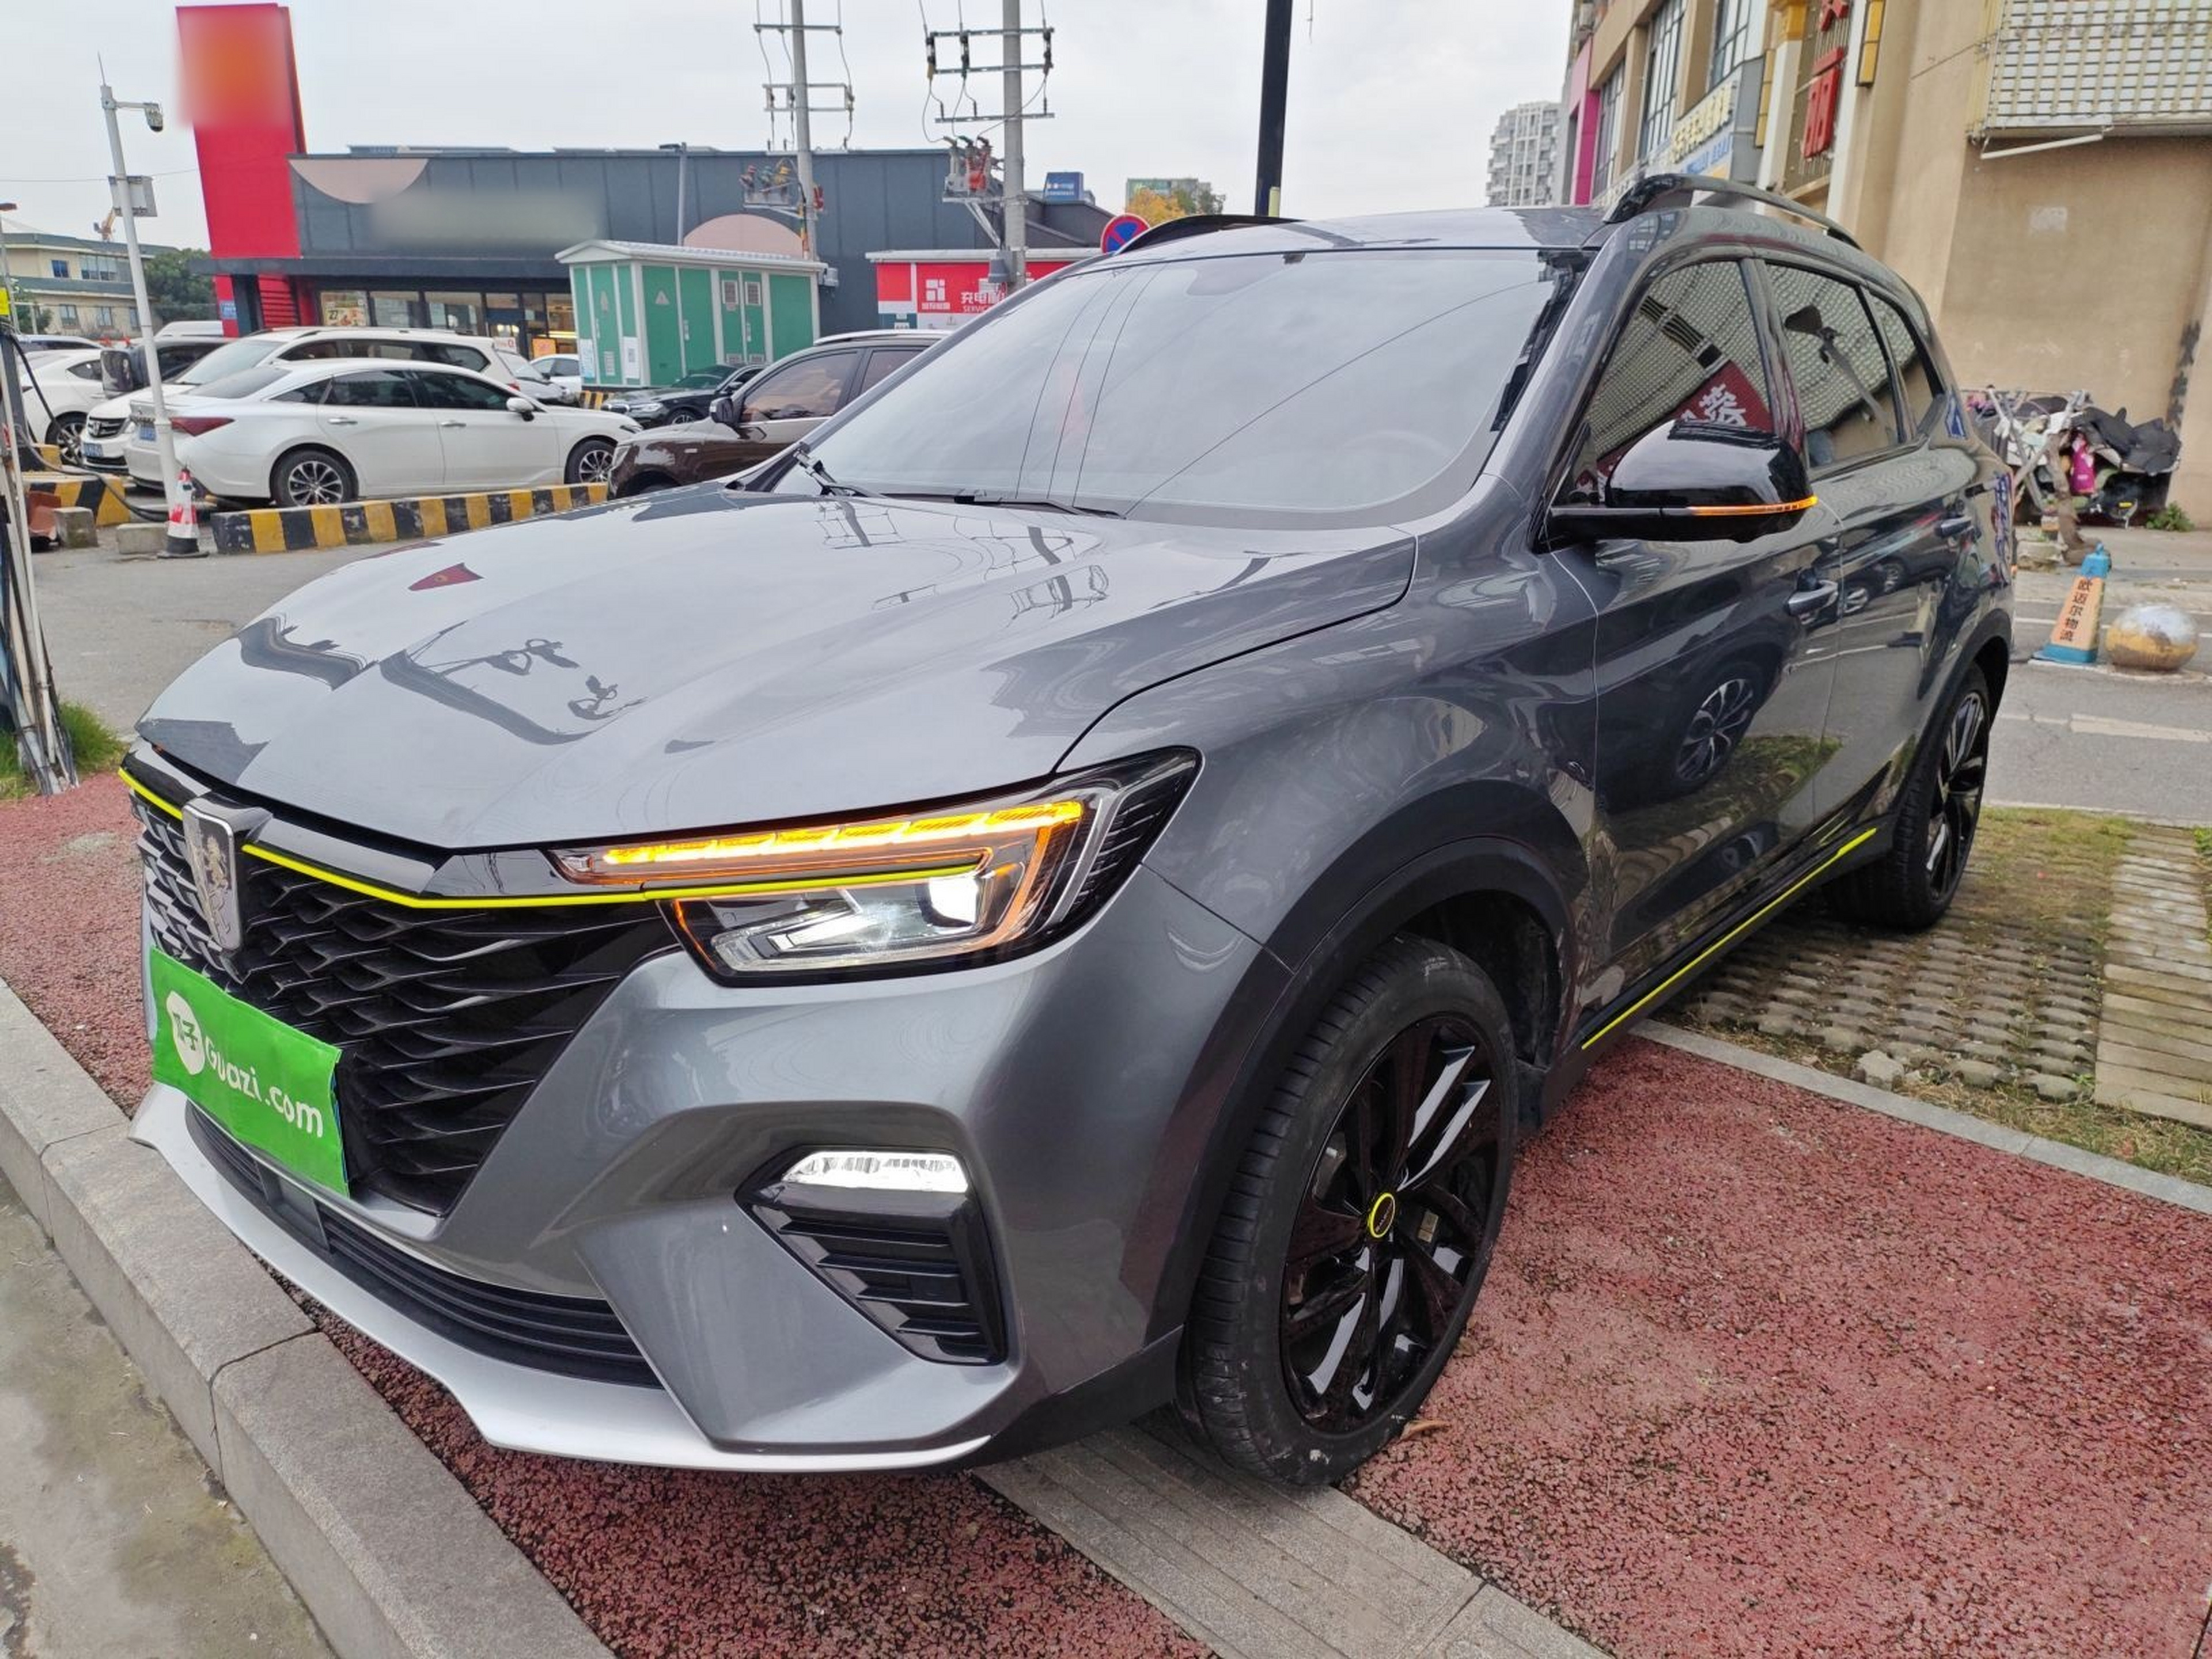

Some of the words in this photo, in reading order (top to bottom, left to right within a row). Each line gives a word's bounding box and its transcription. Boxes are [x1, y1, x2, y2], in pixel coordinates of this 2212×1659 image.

[2059, 579, 2093, 642] 欧迈尔物流
[204, 1036, 324, 1138] Guazi.com
